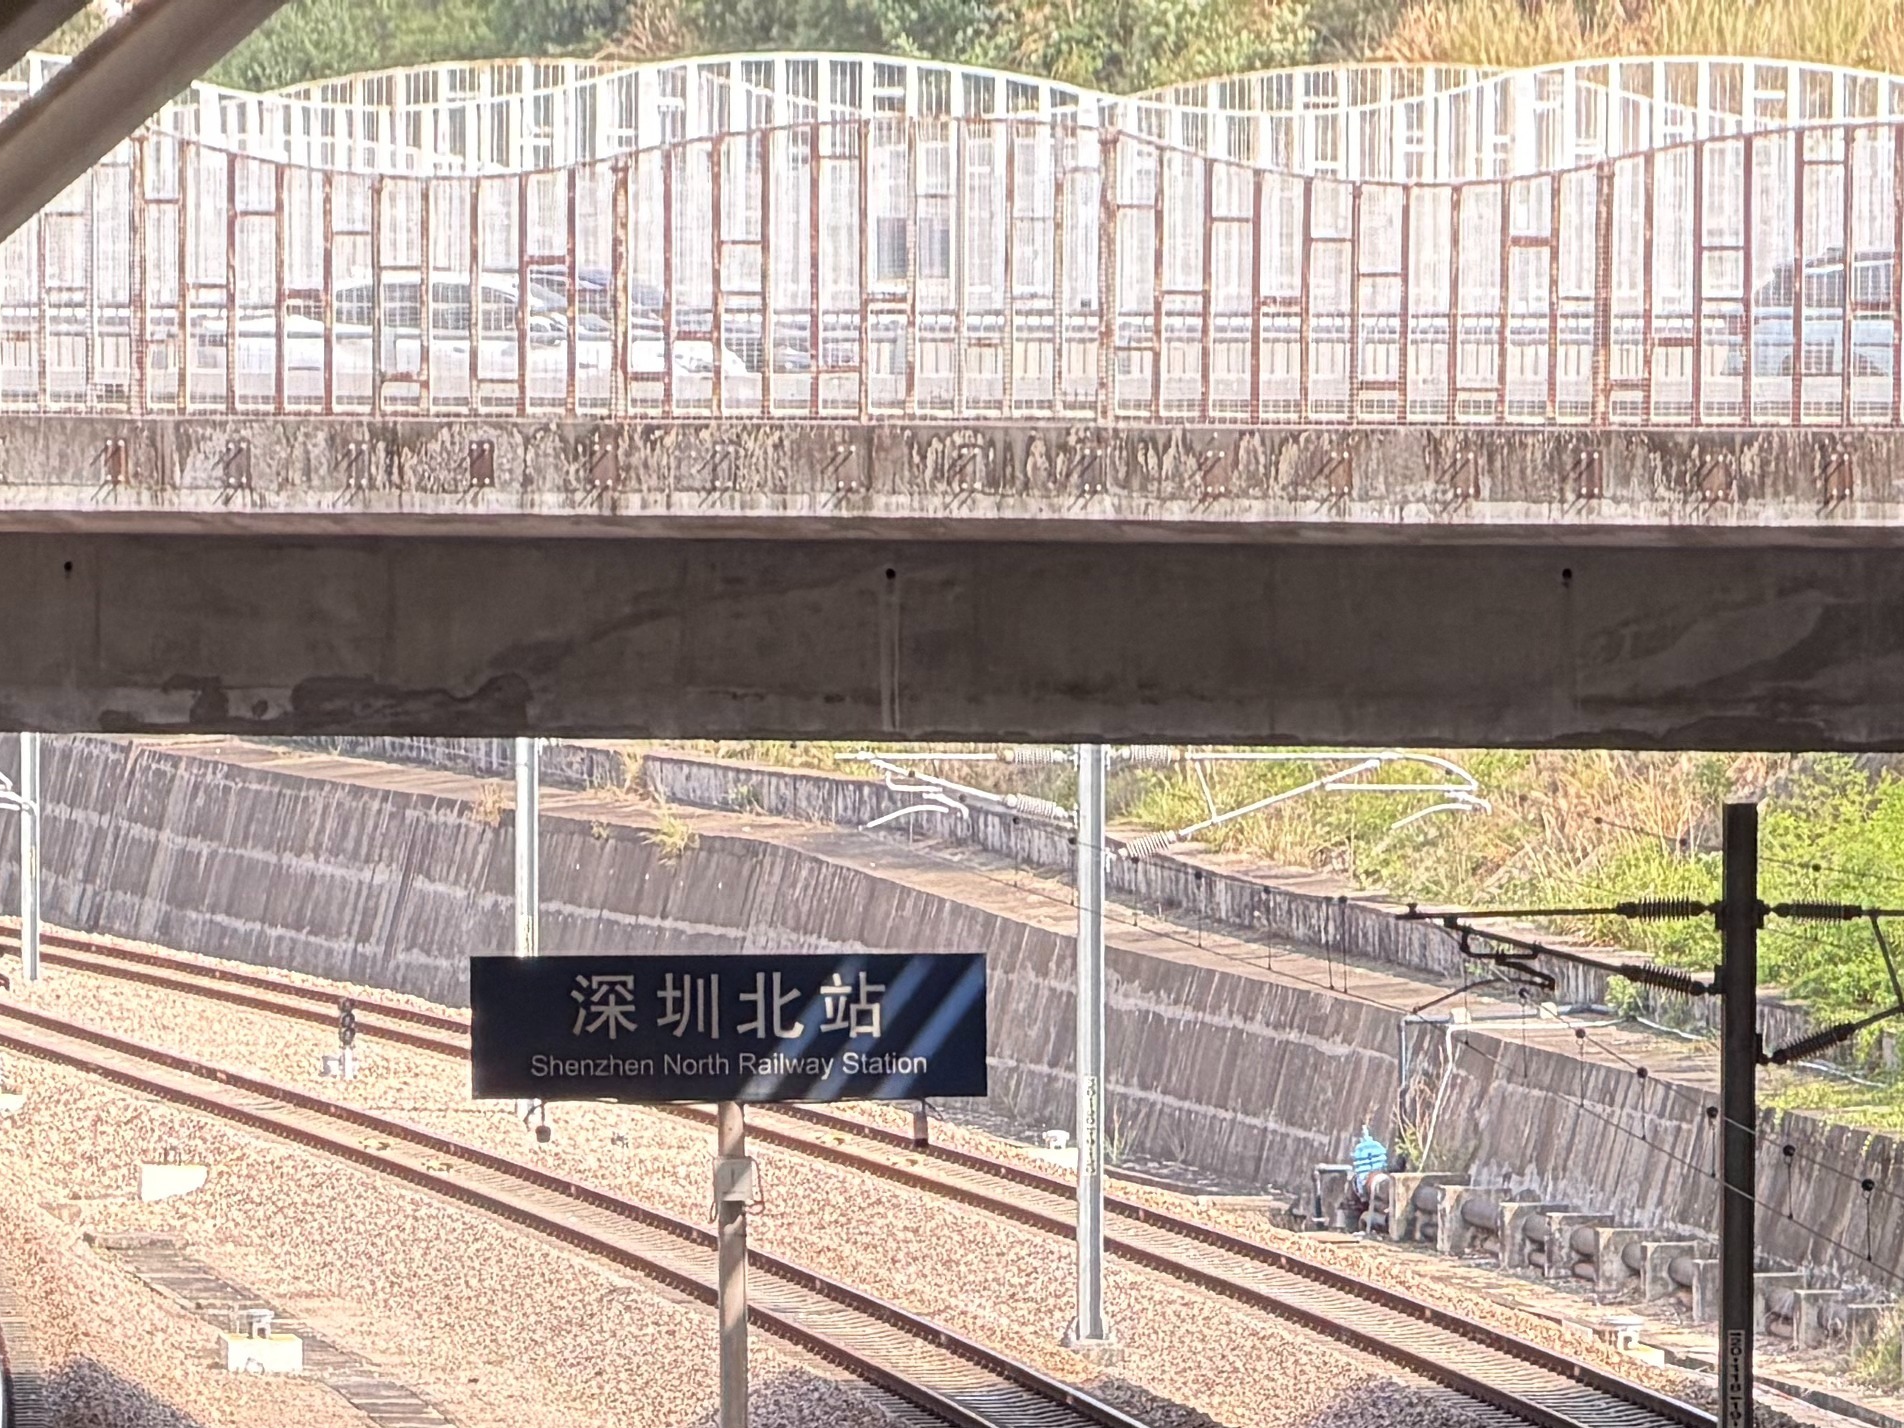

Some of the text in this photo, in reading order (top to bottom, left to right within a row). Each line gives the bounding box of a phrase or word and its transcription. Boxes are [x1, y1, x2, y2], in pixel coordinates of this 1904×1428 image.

[571, 971, 886, 1040] 深圳北站
[530, 1053, 928, 1081] Shenzhen North Railway Station
